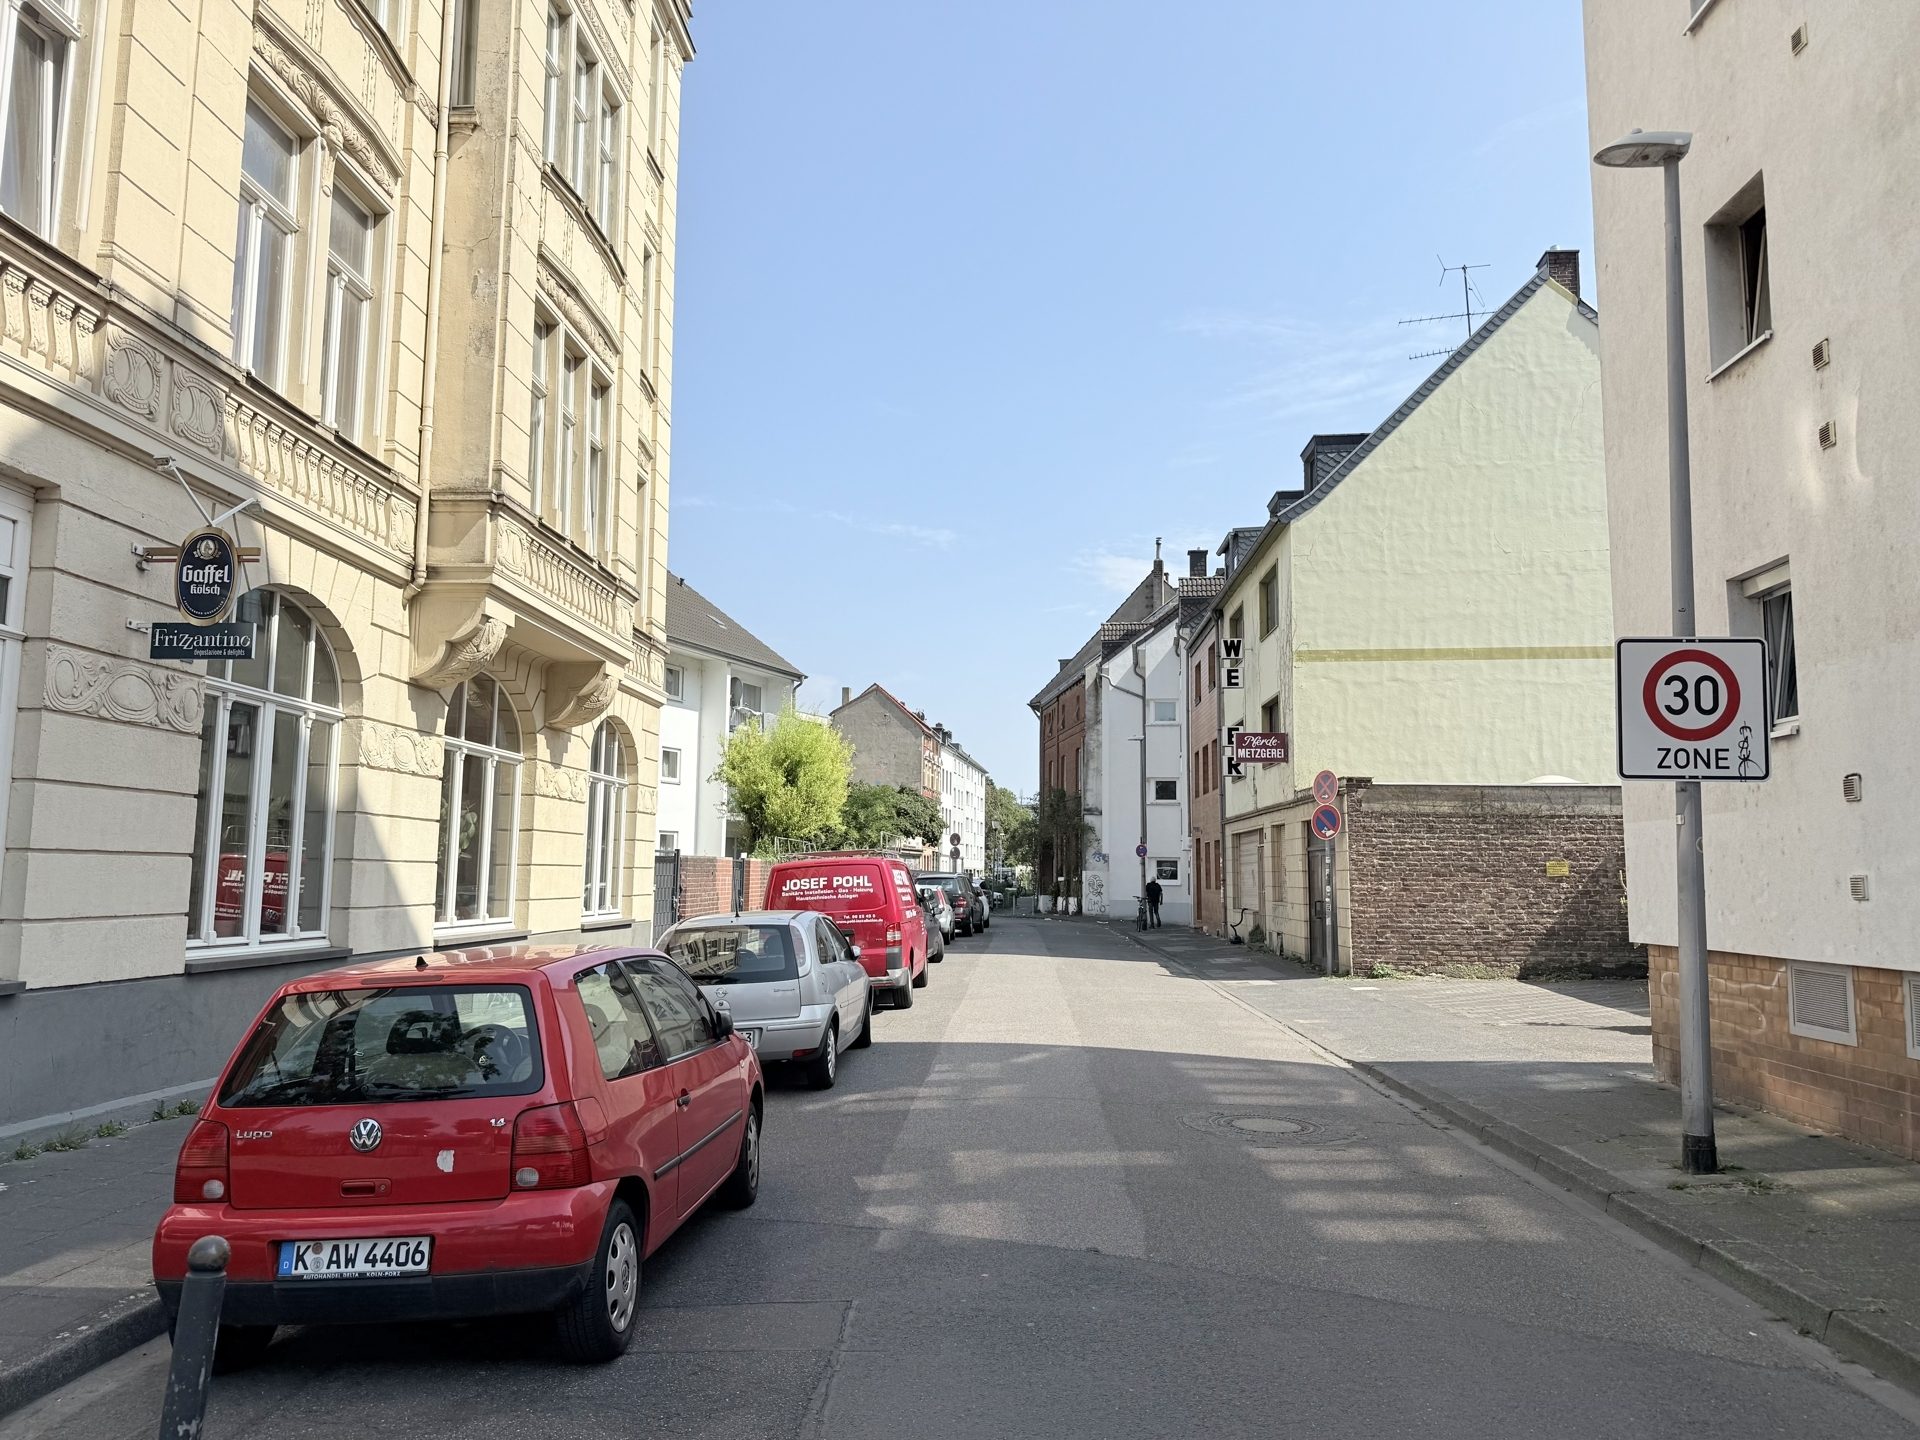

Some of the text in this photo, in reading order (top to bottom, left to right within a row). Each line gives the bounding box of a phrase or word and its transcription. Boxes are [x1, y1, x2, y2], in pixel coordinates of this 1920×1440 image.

[182, 564, 230, 584] Gaffel
[153, 628, 250, 649] Frizzantino
[1664, 675, 1719, 715] 30
[1238, 748, 1284, 758] METZGEREI
[1657, 748, 1730, 769] ZONE
[782, 876, 872, 891] JOSEF POHL
[236, 1130, 273, 1139] Lupo
[294, 1241, 425, 1270] K AW 4406
